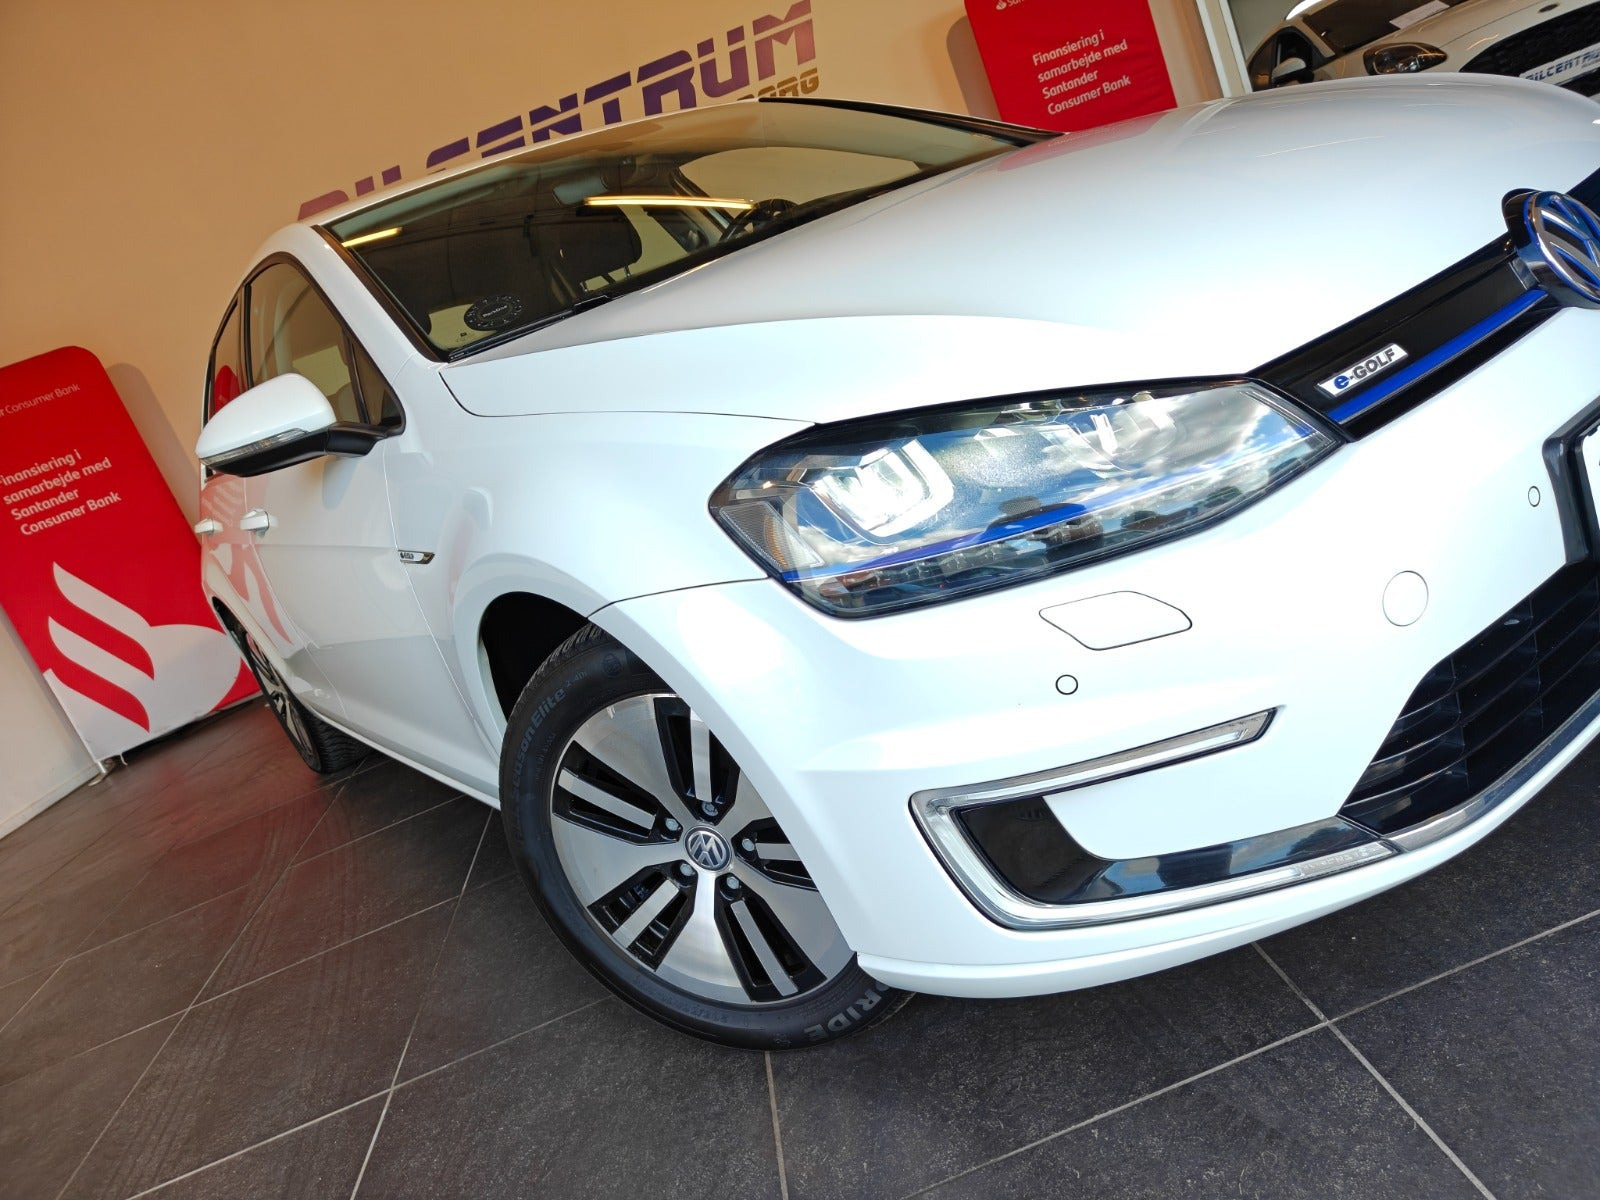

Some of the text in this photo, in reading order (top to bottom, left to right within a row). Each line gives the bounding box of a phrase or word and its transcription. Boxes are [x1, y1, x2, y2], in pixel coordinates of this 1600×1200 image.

[1032, 29, 1105, 66] Finansiering i
[1037, 39, 1128, 83] samarbejde med
[1042, 69, 1098, 99] Santander
[1047, 74, 1131, 115] Consumer Bank
[297, 0, 816, 221] ENTRUM
[1333, 348, 1395, 389] e-GOLF
[5, 391, 55, 414] Consumer
[55, 383, 80, 398] Bank
[0, 449, 82, 487] inansiering i
[3, 456, 112, 505] samarbejde med
[11, 489, 79, 520] Santander
[20, 491, 121, 535] Consumer Bank
[531, 687, 566, 728] Elite
